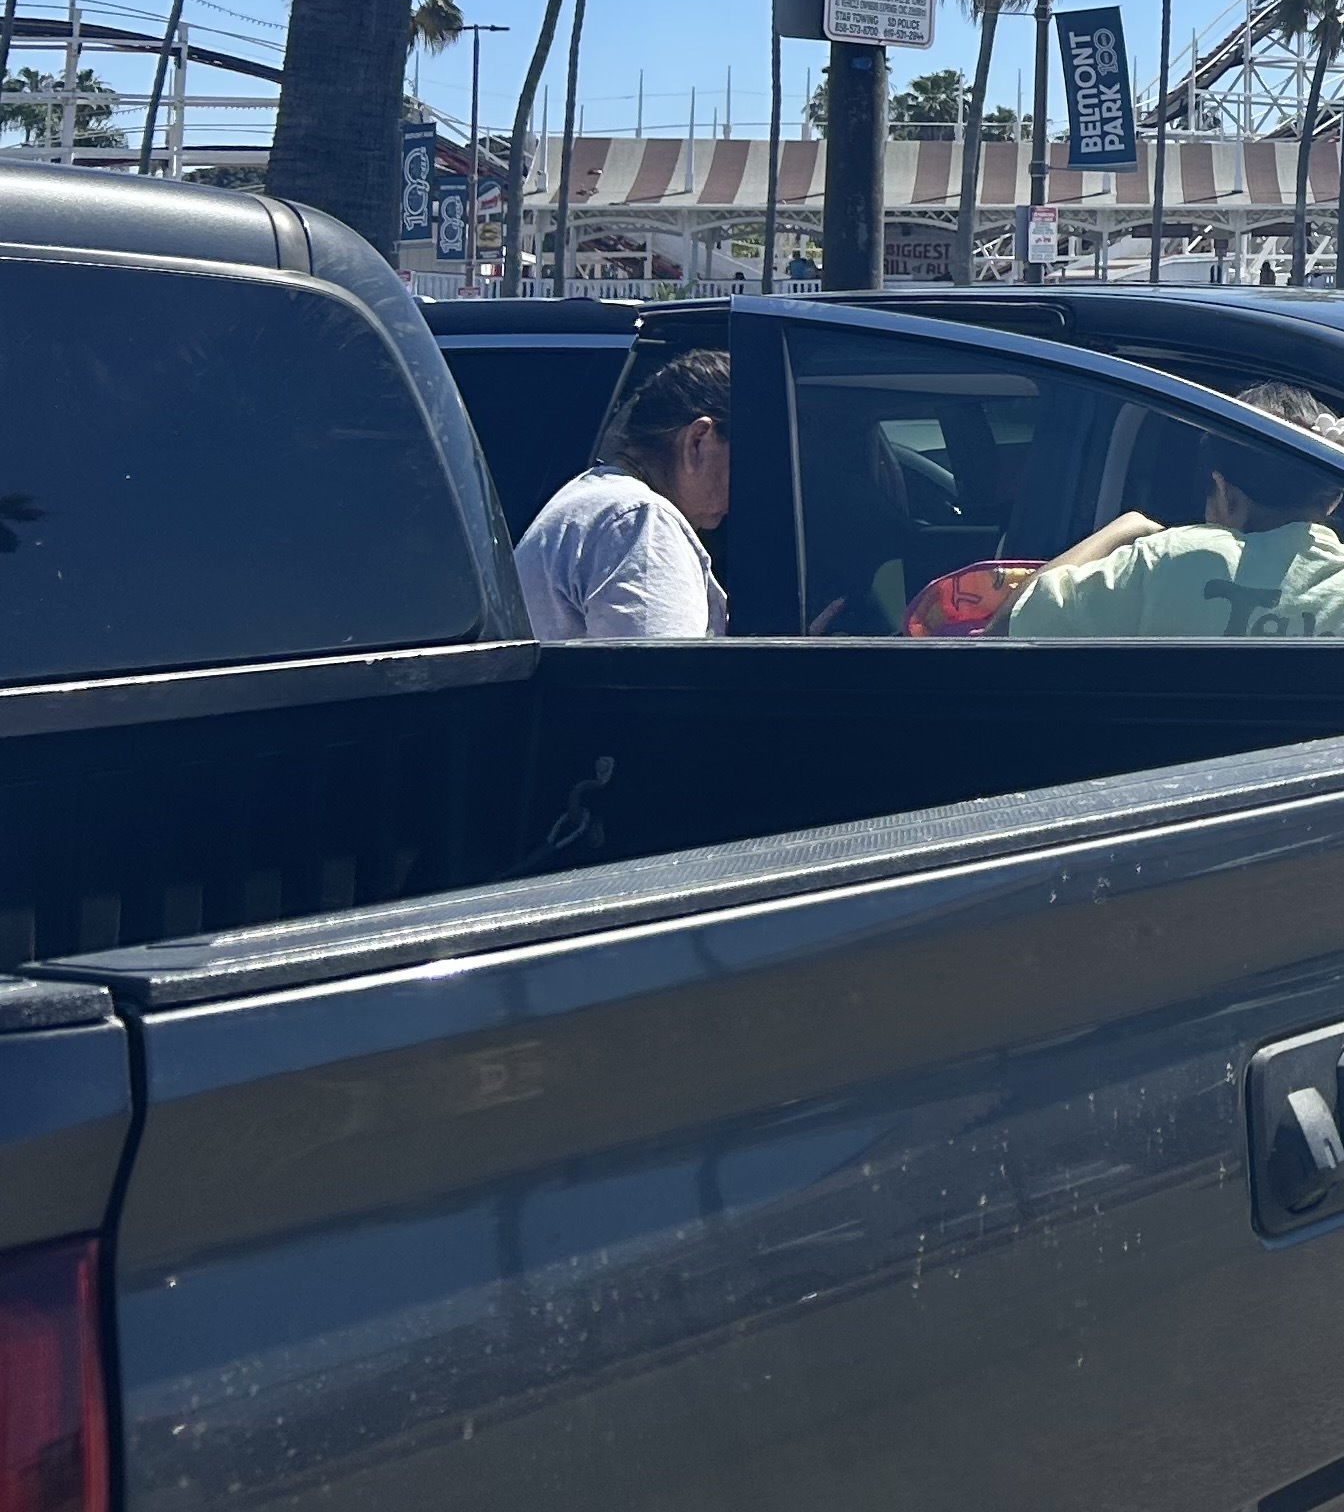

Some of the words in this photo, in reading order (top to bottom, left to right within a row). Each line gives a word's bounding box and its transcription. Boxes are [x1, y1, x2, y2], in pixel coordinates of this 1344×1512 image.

[897, 18, 921, 30] POLICE
[1093, 27, 1119, 76] 100
[1099, 82, 1125, 152] PARK
[403, 147, 430, 232] 100
